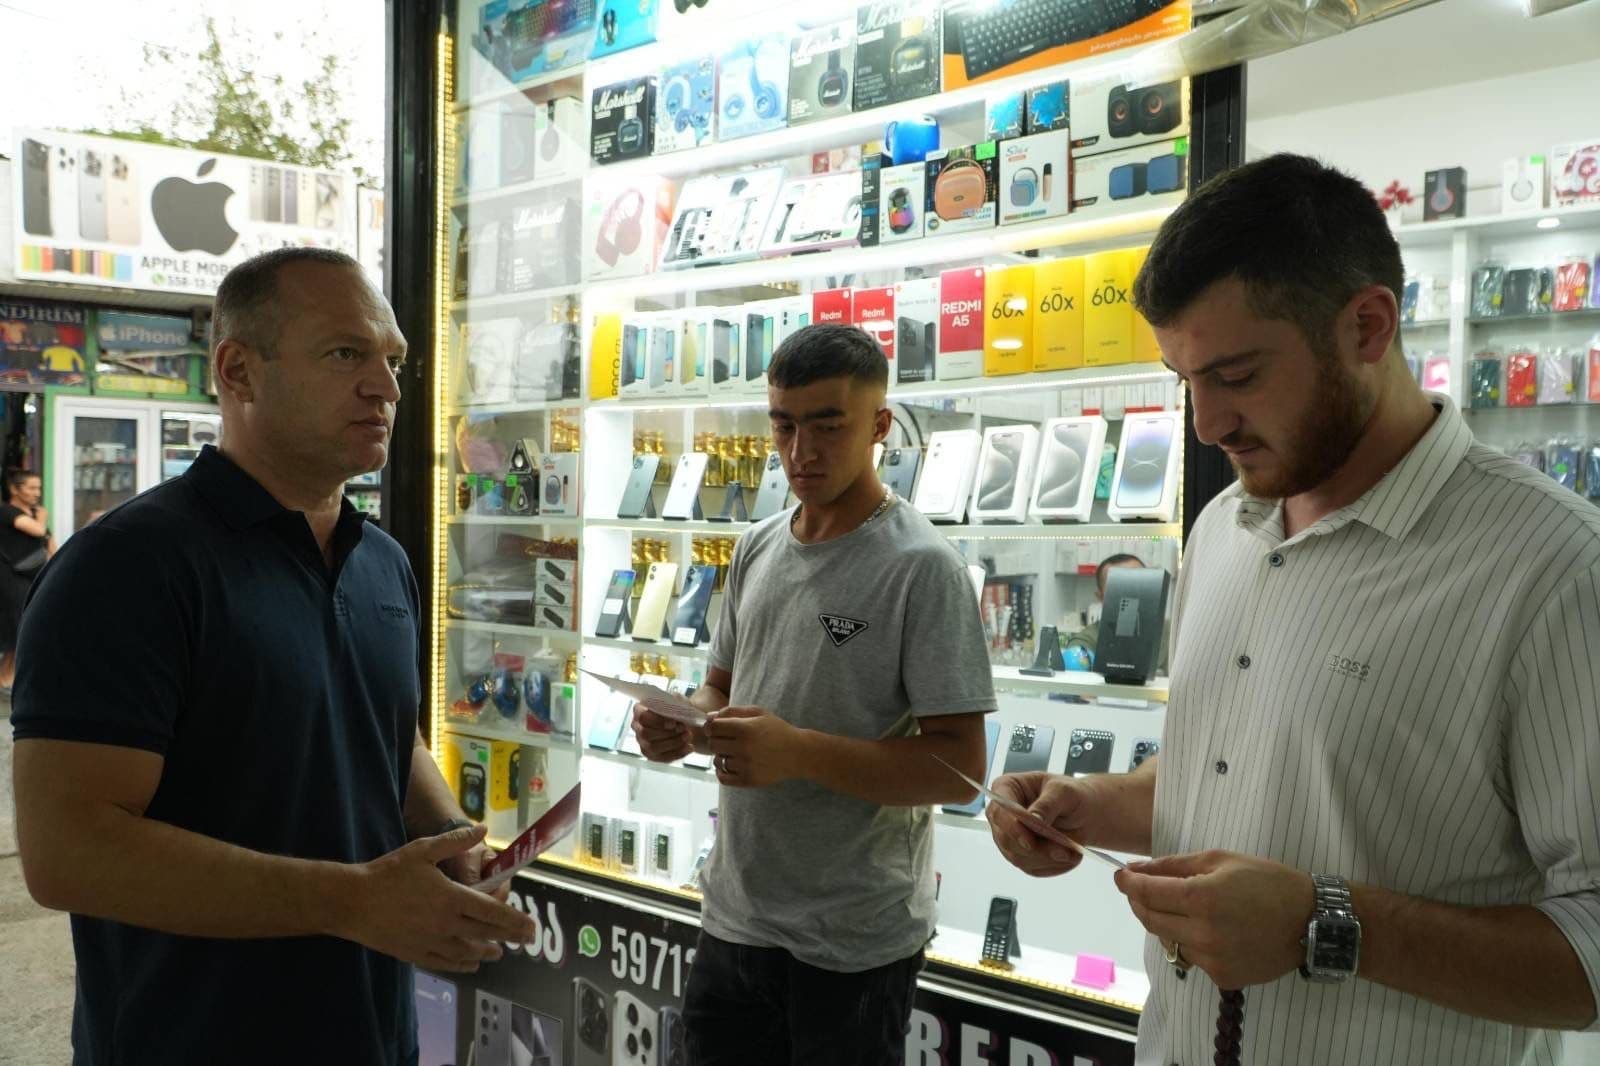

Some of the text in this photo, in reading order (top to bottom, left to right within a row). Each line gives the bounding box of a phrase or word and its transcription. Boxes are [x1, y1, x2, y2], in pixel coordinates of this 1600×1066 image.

[141, 256, 191, 274] APPLE
[1040, 293, 1074, 313] 60x
[1091, 286, 1128, 306] 60x
[820, 310, 842, 320] Redmi
[861, 308, 886, 318] Redmi
[941, 299, 982, 315] REDMI
[951, 315, 970, 328] A5
[120, 325, 188, 346] iPhone
[611, 358, 620, 396] POCO
[1329, 655, 1371, 677] BOSS
